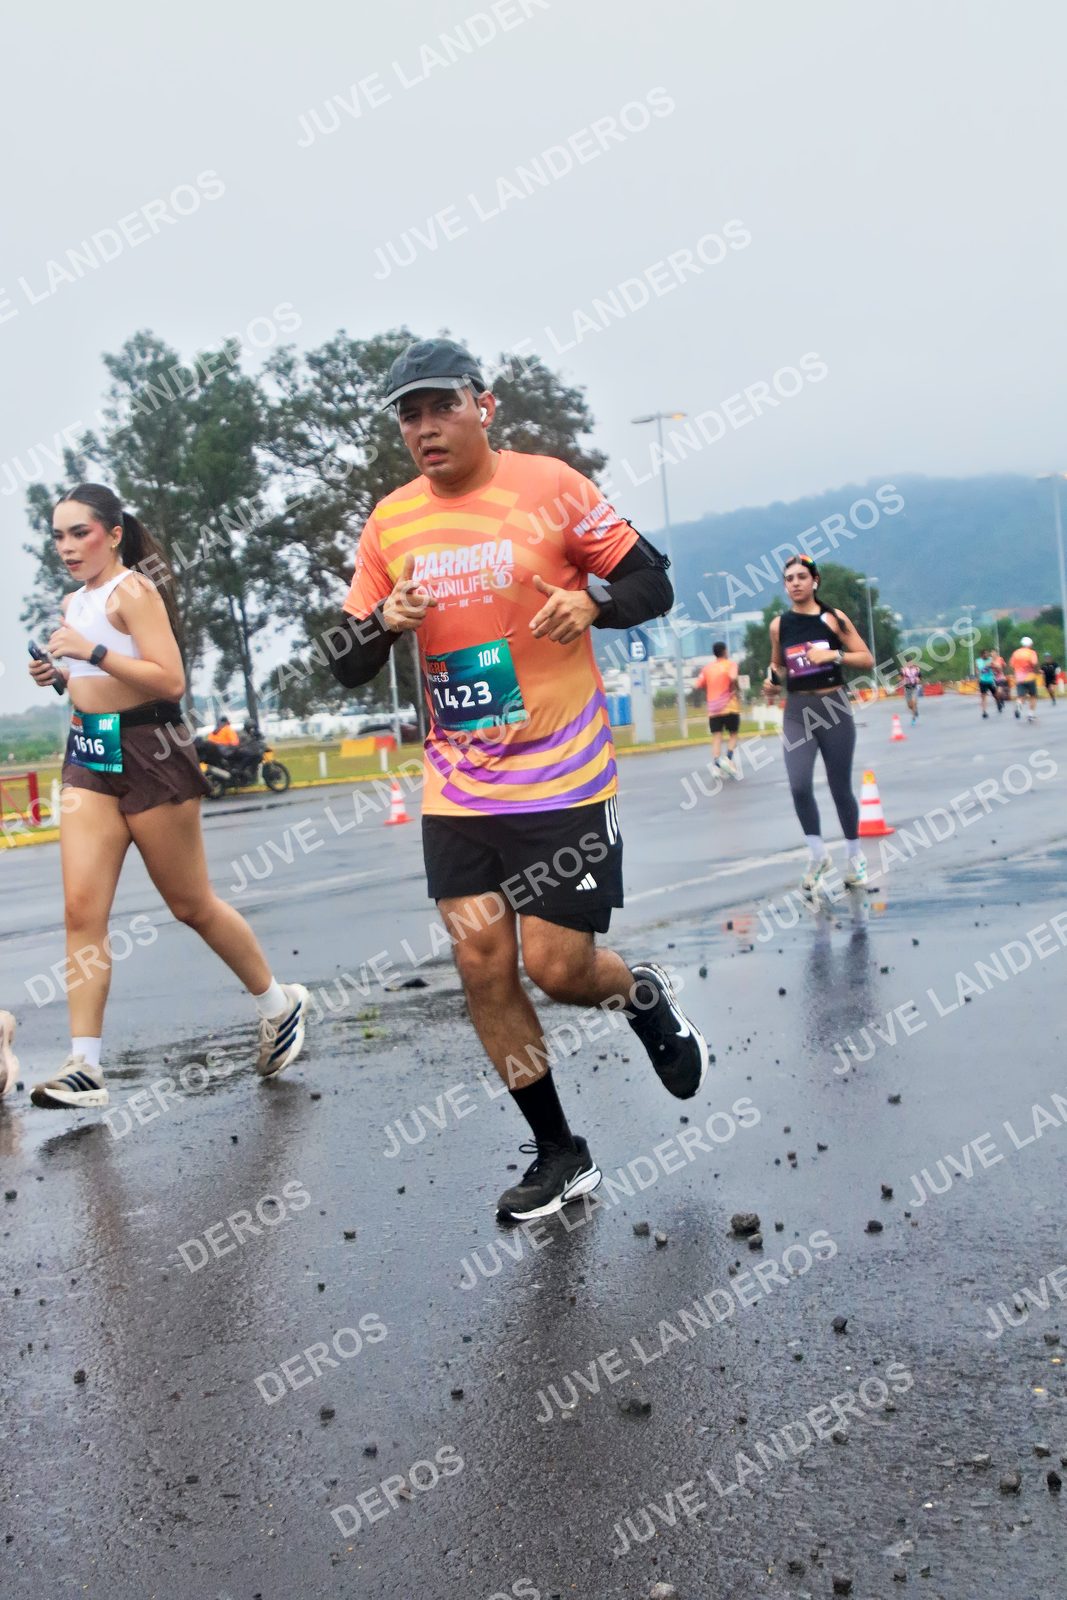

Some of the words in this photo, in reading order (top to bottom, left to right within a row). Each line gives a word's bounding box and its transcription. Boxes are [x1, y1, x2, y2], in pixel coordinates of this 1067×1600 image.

[412, 539, 513, 584] CARRERA
[414, 571, 490, 600] OMNILIFE
[477, 647, 501, 668] 10K
[433, 681, 493, 709] 1423
[74, 734, 106, 756] 1616
